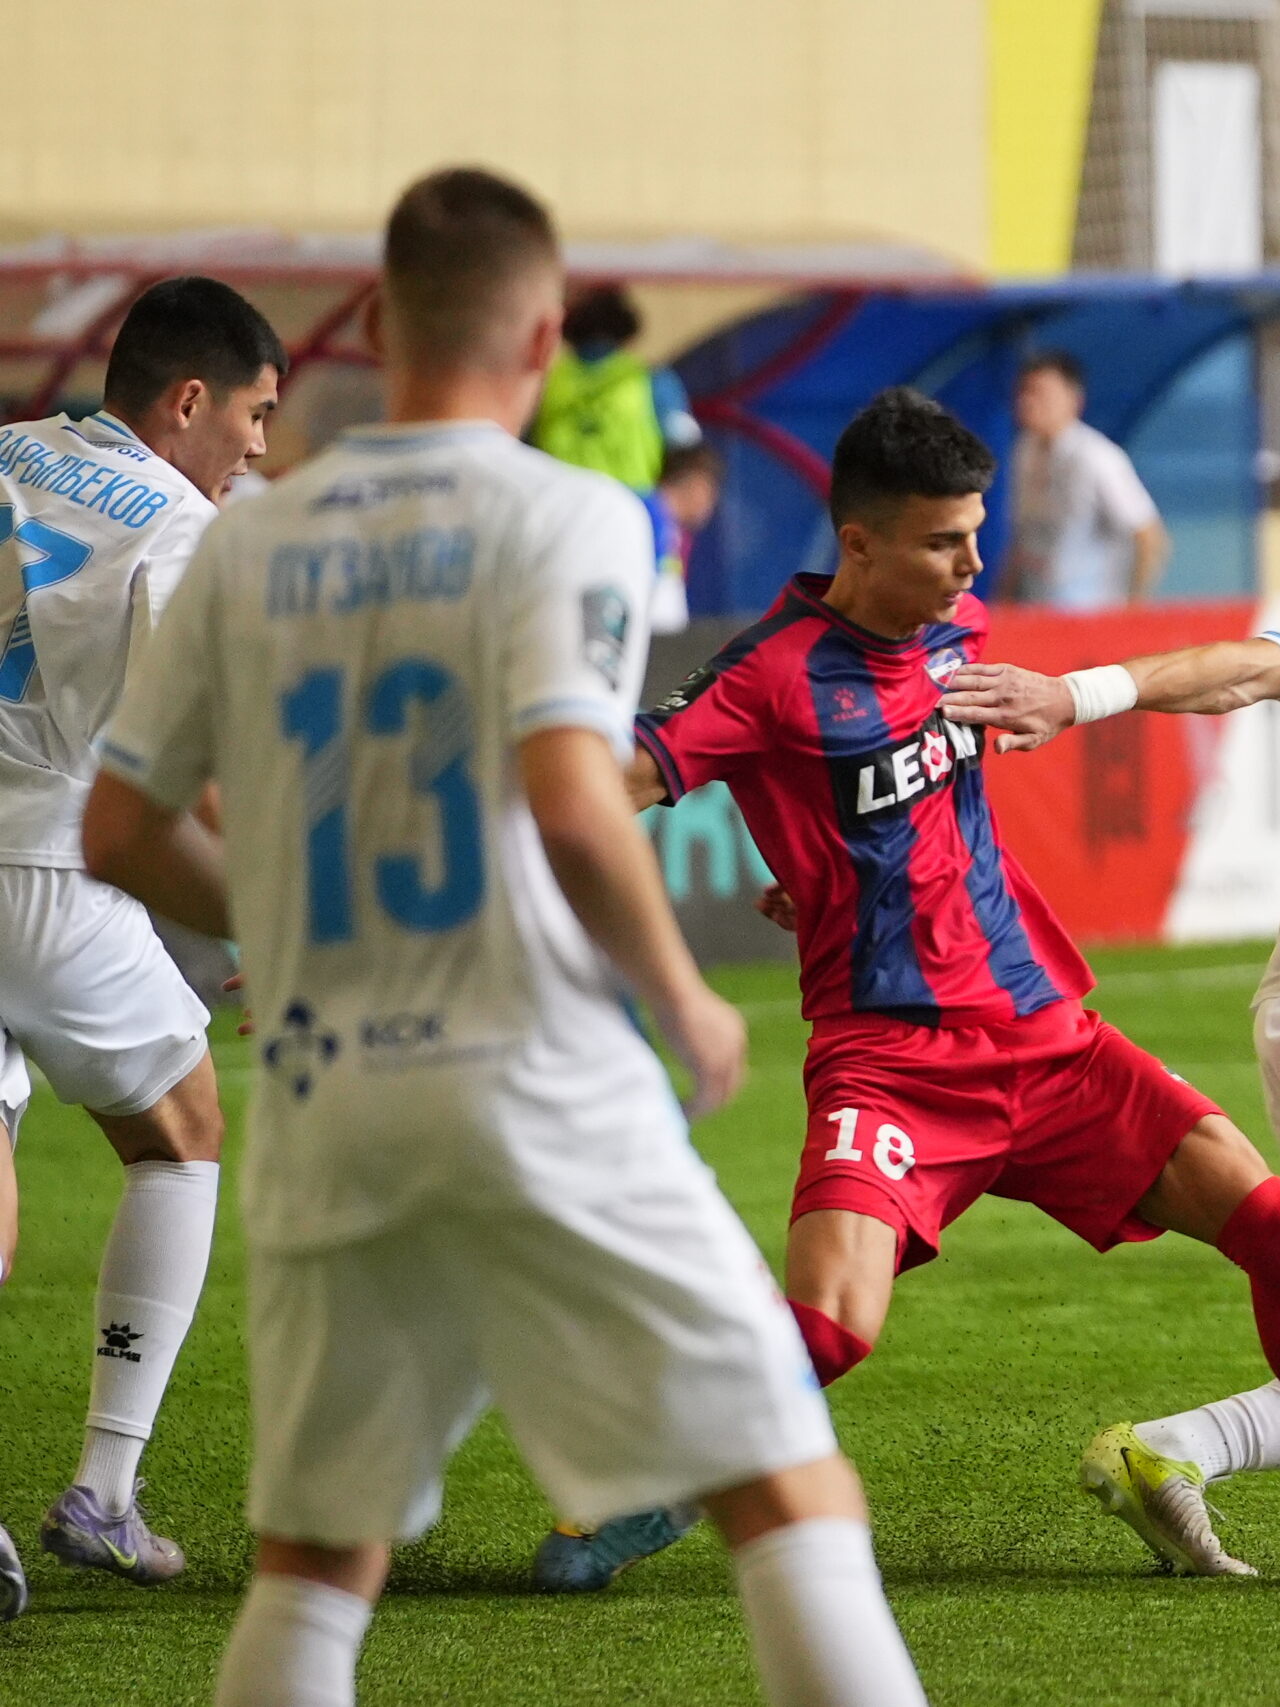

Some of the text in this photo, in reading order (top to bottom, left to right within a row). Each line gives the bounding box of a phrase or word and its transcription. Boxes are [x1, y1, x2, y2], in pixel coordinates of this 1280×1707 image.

[281, 659, 489, 943] 13
[824, 1106, 916, 1181] 18
[97, 1346, 142, 1363] KELME
